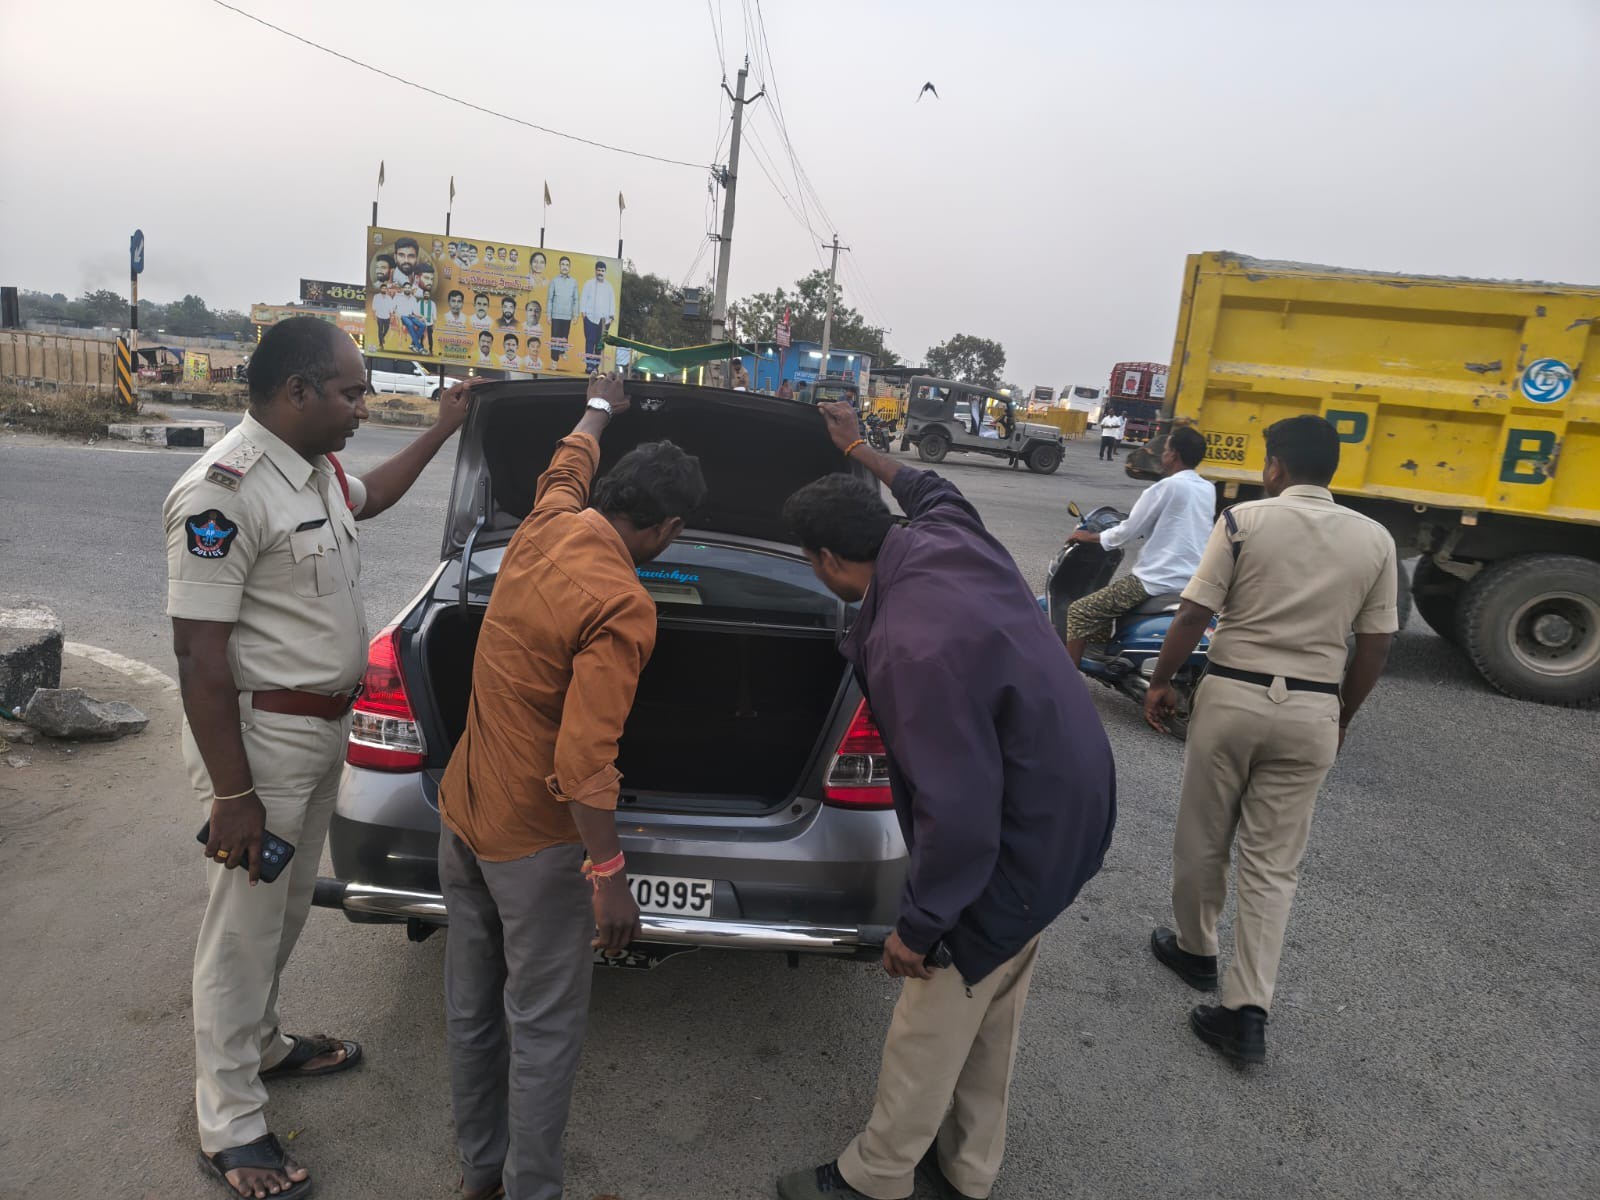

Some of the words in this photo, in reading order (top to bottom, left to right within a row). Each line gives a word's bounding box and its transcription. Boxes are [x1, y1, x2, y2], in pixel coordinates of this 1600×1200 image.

[1225, 435, 1245, 448] 02
[1499, 428, 1557, 484] B
[191, 547, 224, 556] POLICE
